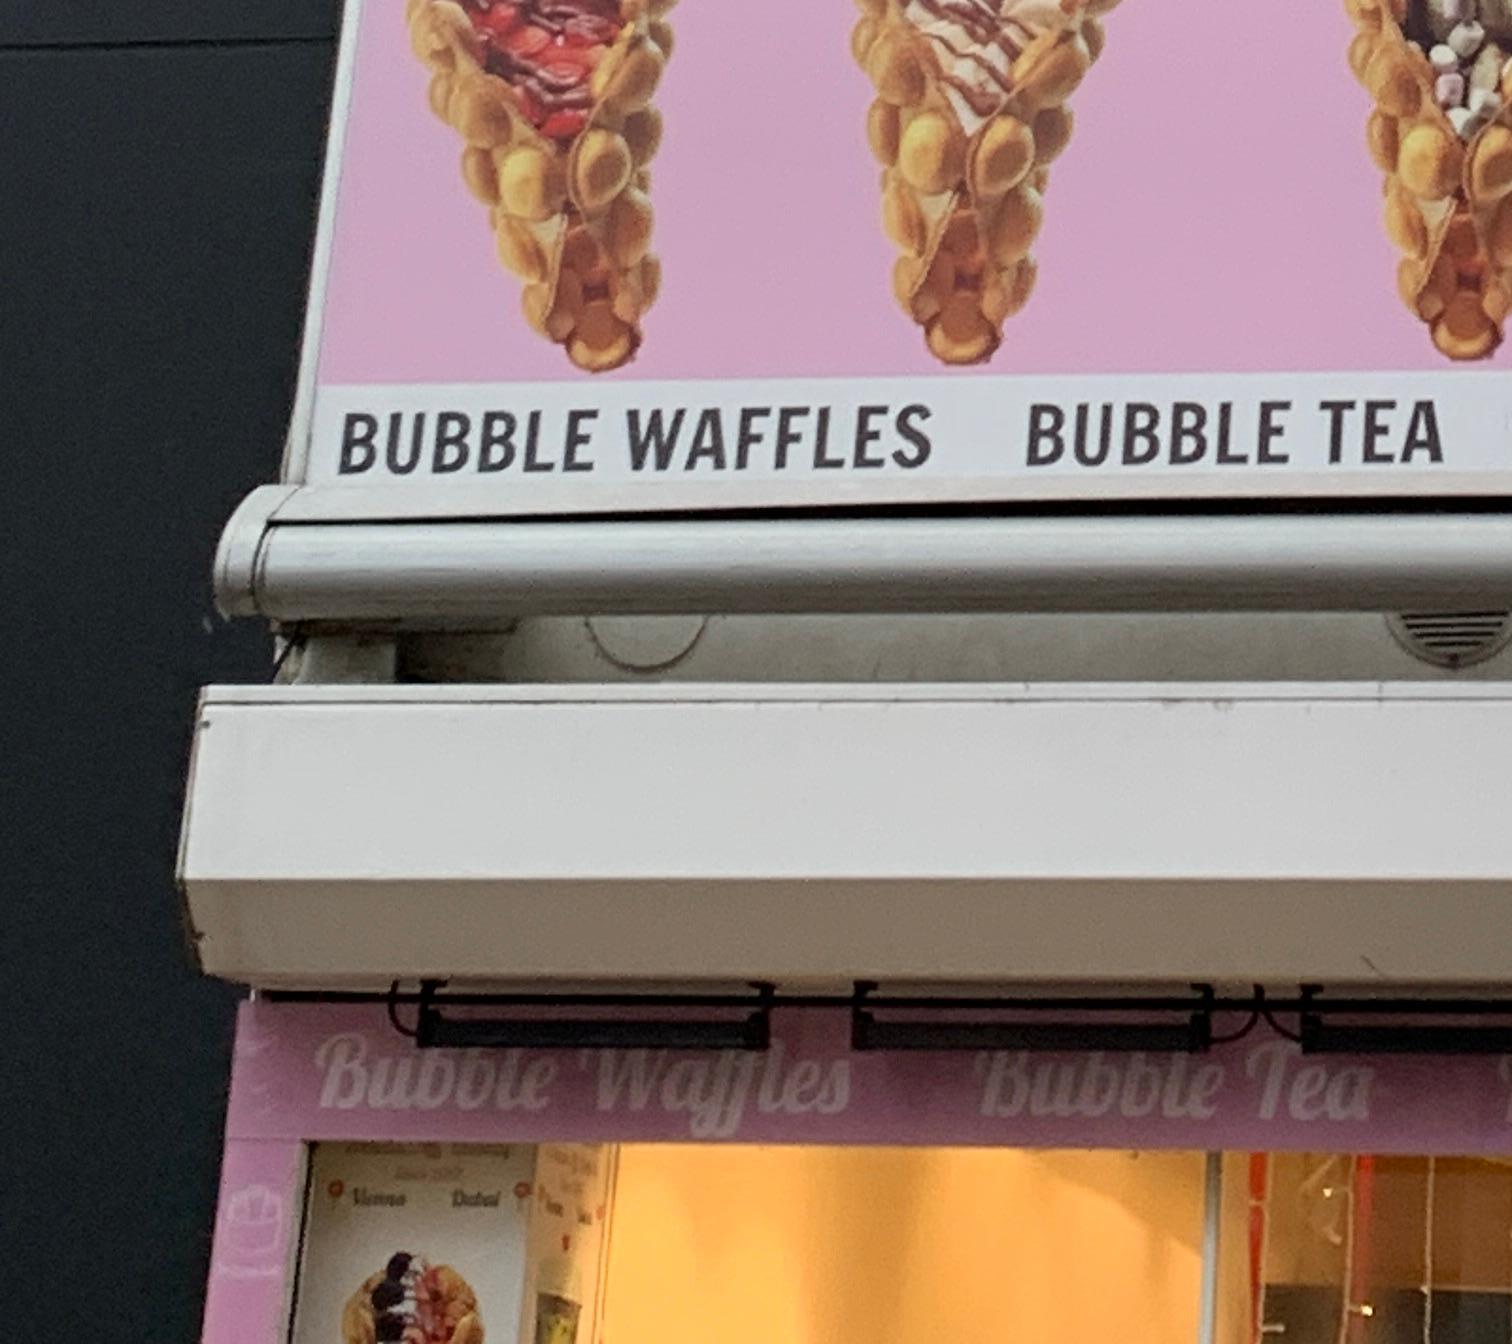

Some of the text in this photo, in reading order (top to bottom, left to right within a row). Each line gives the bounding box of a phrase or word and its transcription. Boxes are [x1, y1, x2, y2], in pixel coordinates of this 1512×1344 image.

[337, 403, 932, 475] BUBBLE WAFFLES
[1025, 399, 1443, 467] BUBBLE TEA
[315, 1032, 852, 1139] Bubble Waffles
[975, 1042, 1376, 1121] Bubble Tea
